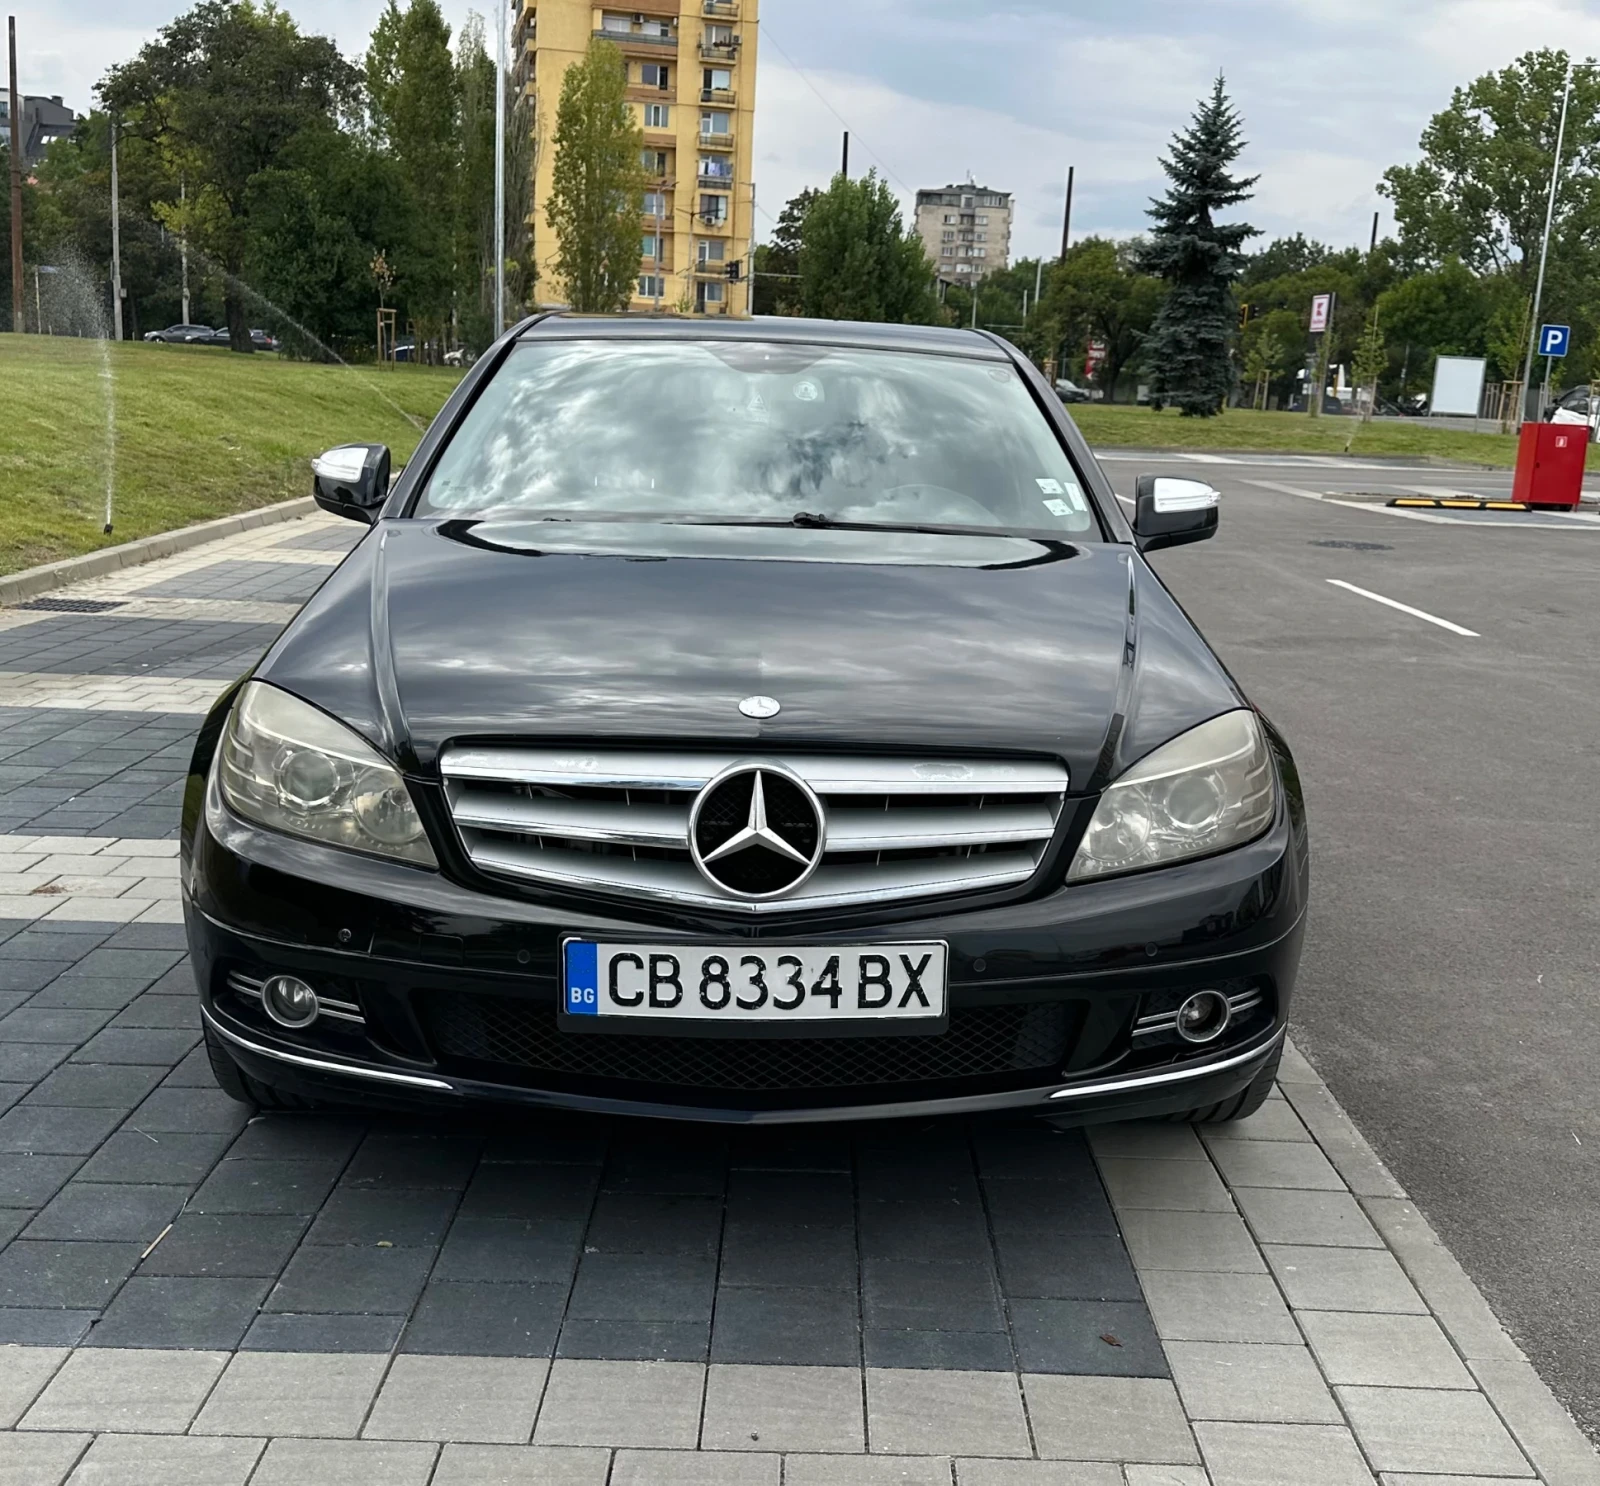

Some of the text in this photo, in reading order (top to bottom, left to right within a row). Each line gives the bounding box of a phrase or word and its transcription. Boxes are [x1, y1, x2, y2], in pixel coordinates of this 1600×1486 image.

[1545, 330, 1563, 352] P
[608, 952, 933, 1011] CB 8334 BX
[571, 986, 595, 1004] BG
